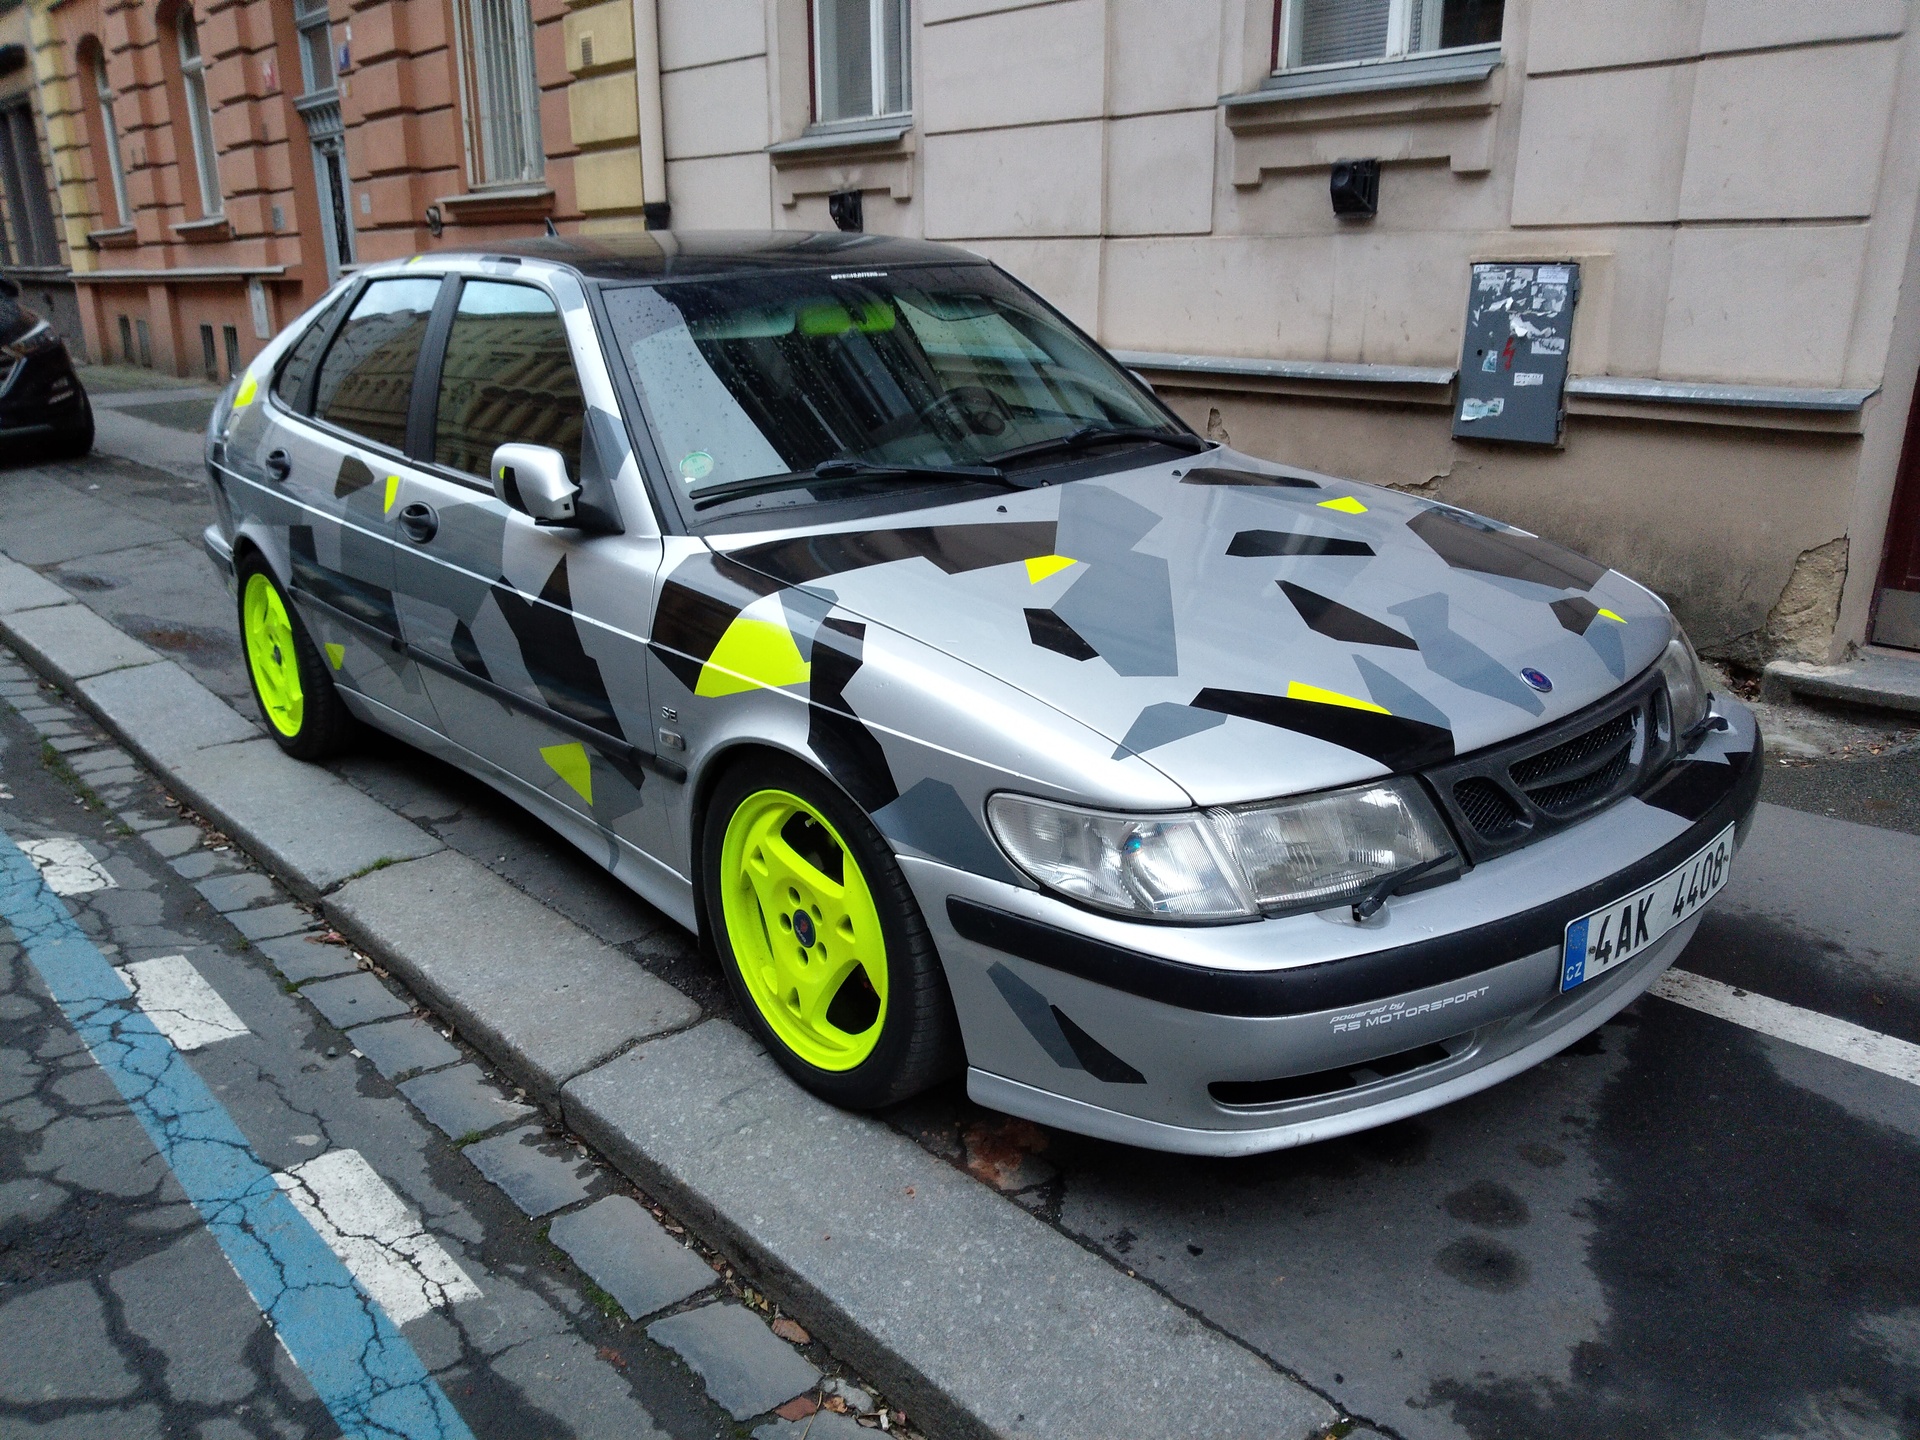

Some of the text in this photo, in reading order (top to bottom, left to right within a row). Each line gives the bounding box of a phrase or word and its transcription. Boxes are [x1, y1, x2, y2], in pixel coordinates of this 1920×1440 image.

[661, 706, 678, 722] SE
[1594, 841, 1725, 965] 4AK 4408
[1566, 961, 1582, 982] CZ
[1330, 1001, 1406, 1024] powered by
[1333, 986, 1489, 1034] RS MOTORSPORT
